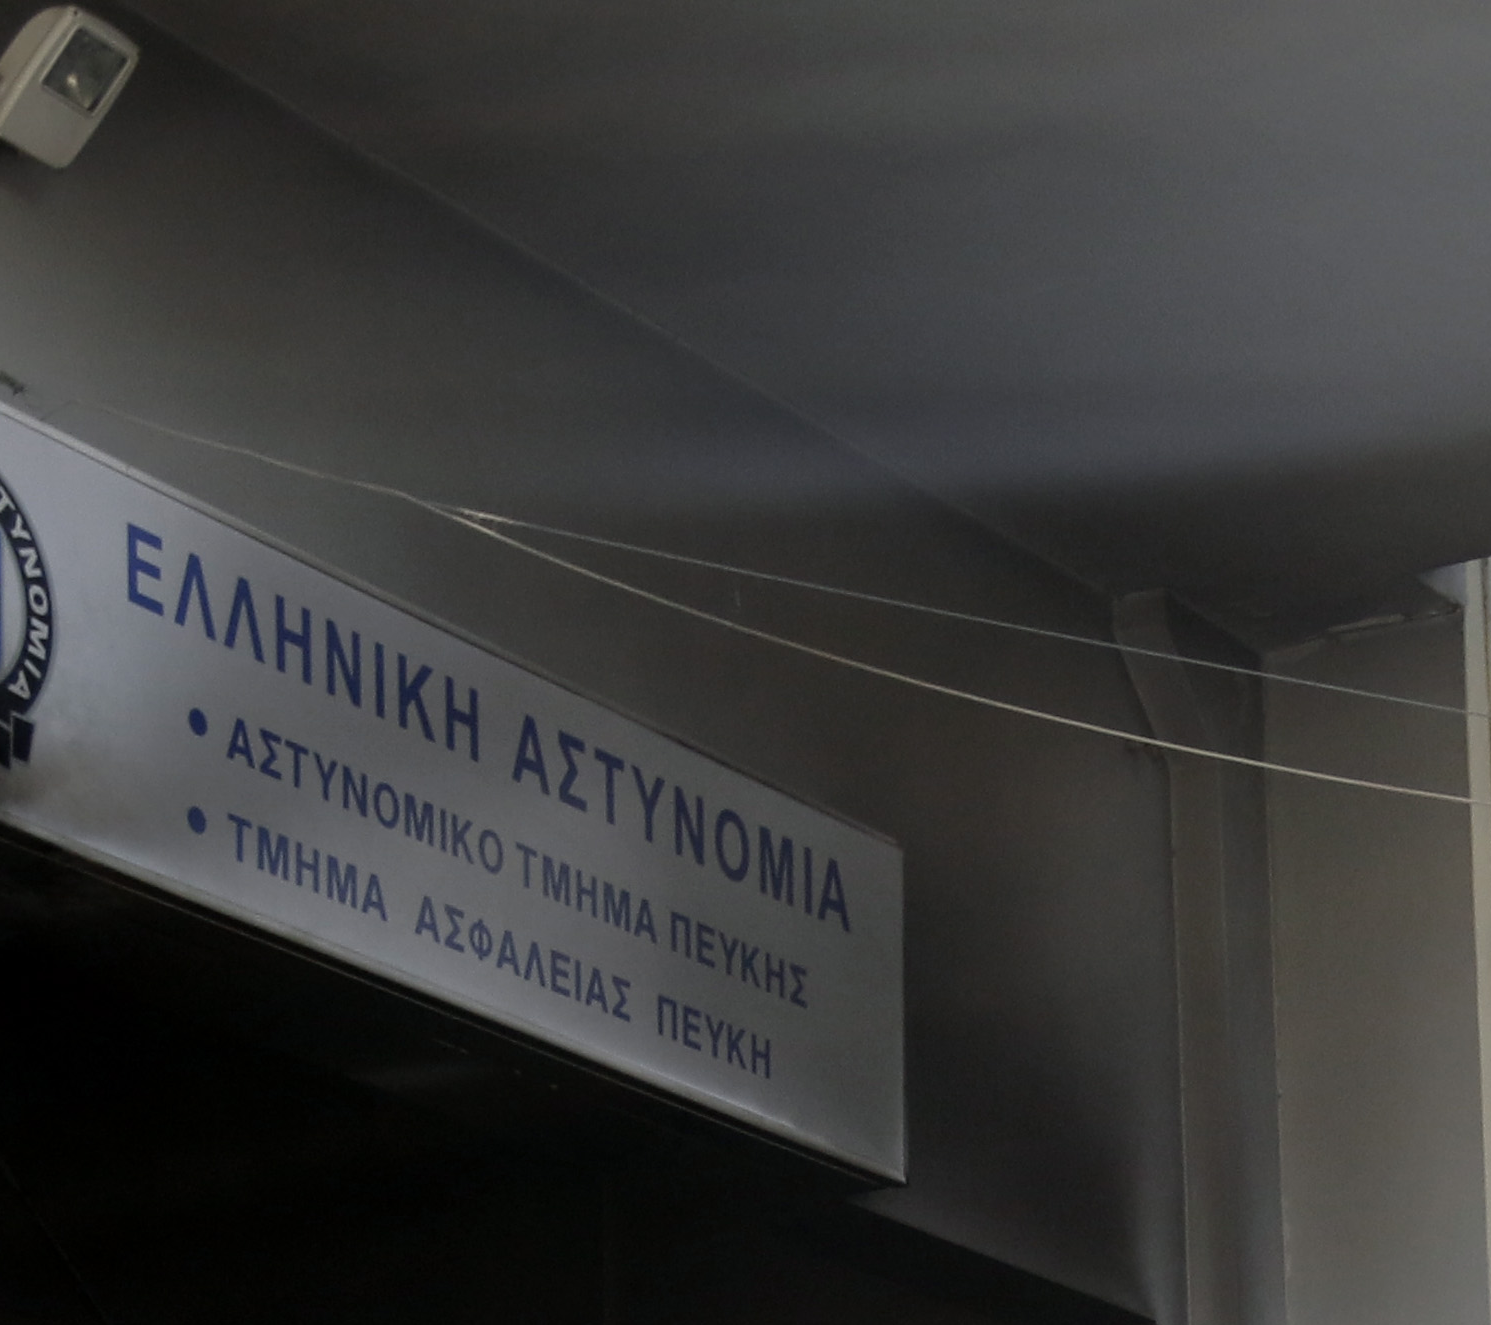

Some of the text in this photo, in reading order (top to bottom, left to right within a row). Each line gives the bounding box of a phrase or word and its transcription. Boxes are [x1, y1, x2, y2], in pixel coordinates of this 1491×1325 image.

[126, 522, 851, 934] ΕΛΛΗΝΙΚΗ ΑΣΤΥΝΟΜΙΑ
[226, 717, 809, 1010] ΑΣΤΥΝΟΜΙΚΟ ΤΜΗΜΑ ΠΕΥΚΗΣ
[227, 812, 773, 1081] ΤΜΗΜΑ ΑΣΦΑΛΕΙΑΣ ΠΕΥΚΗ
